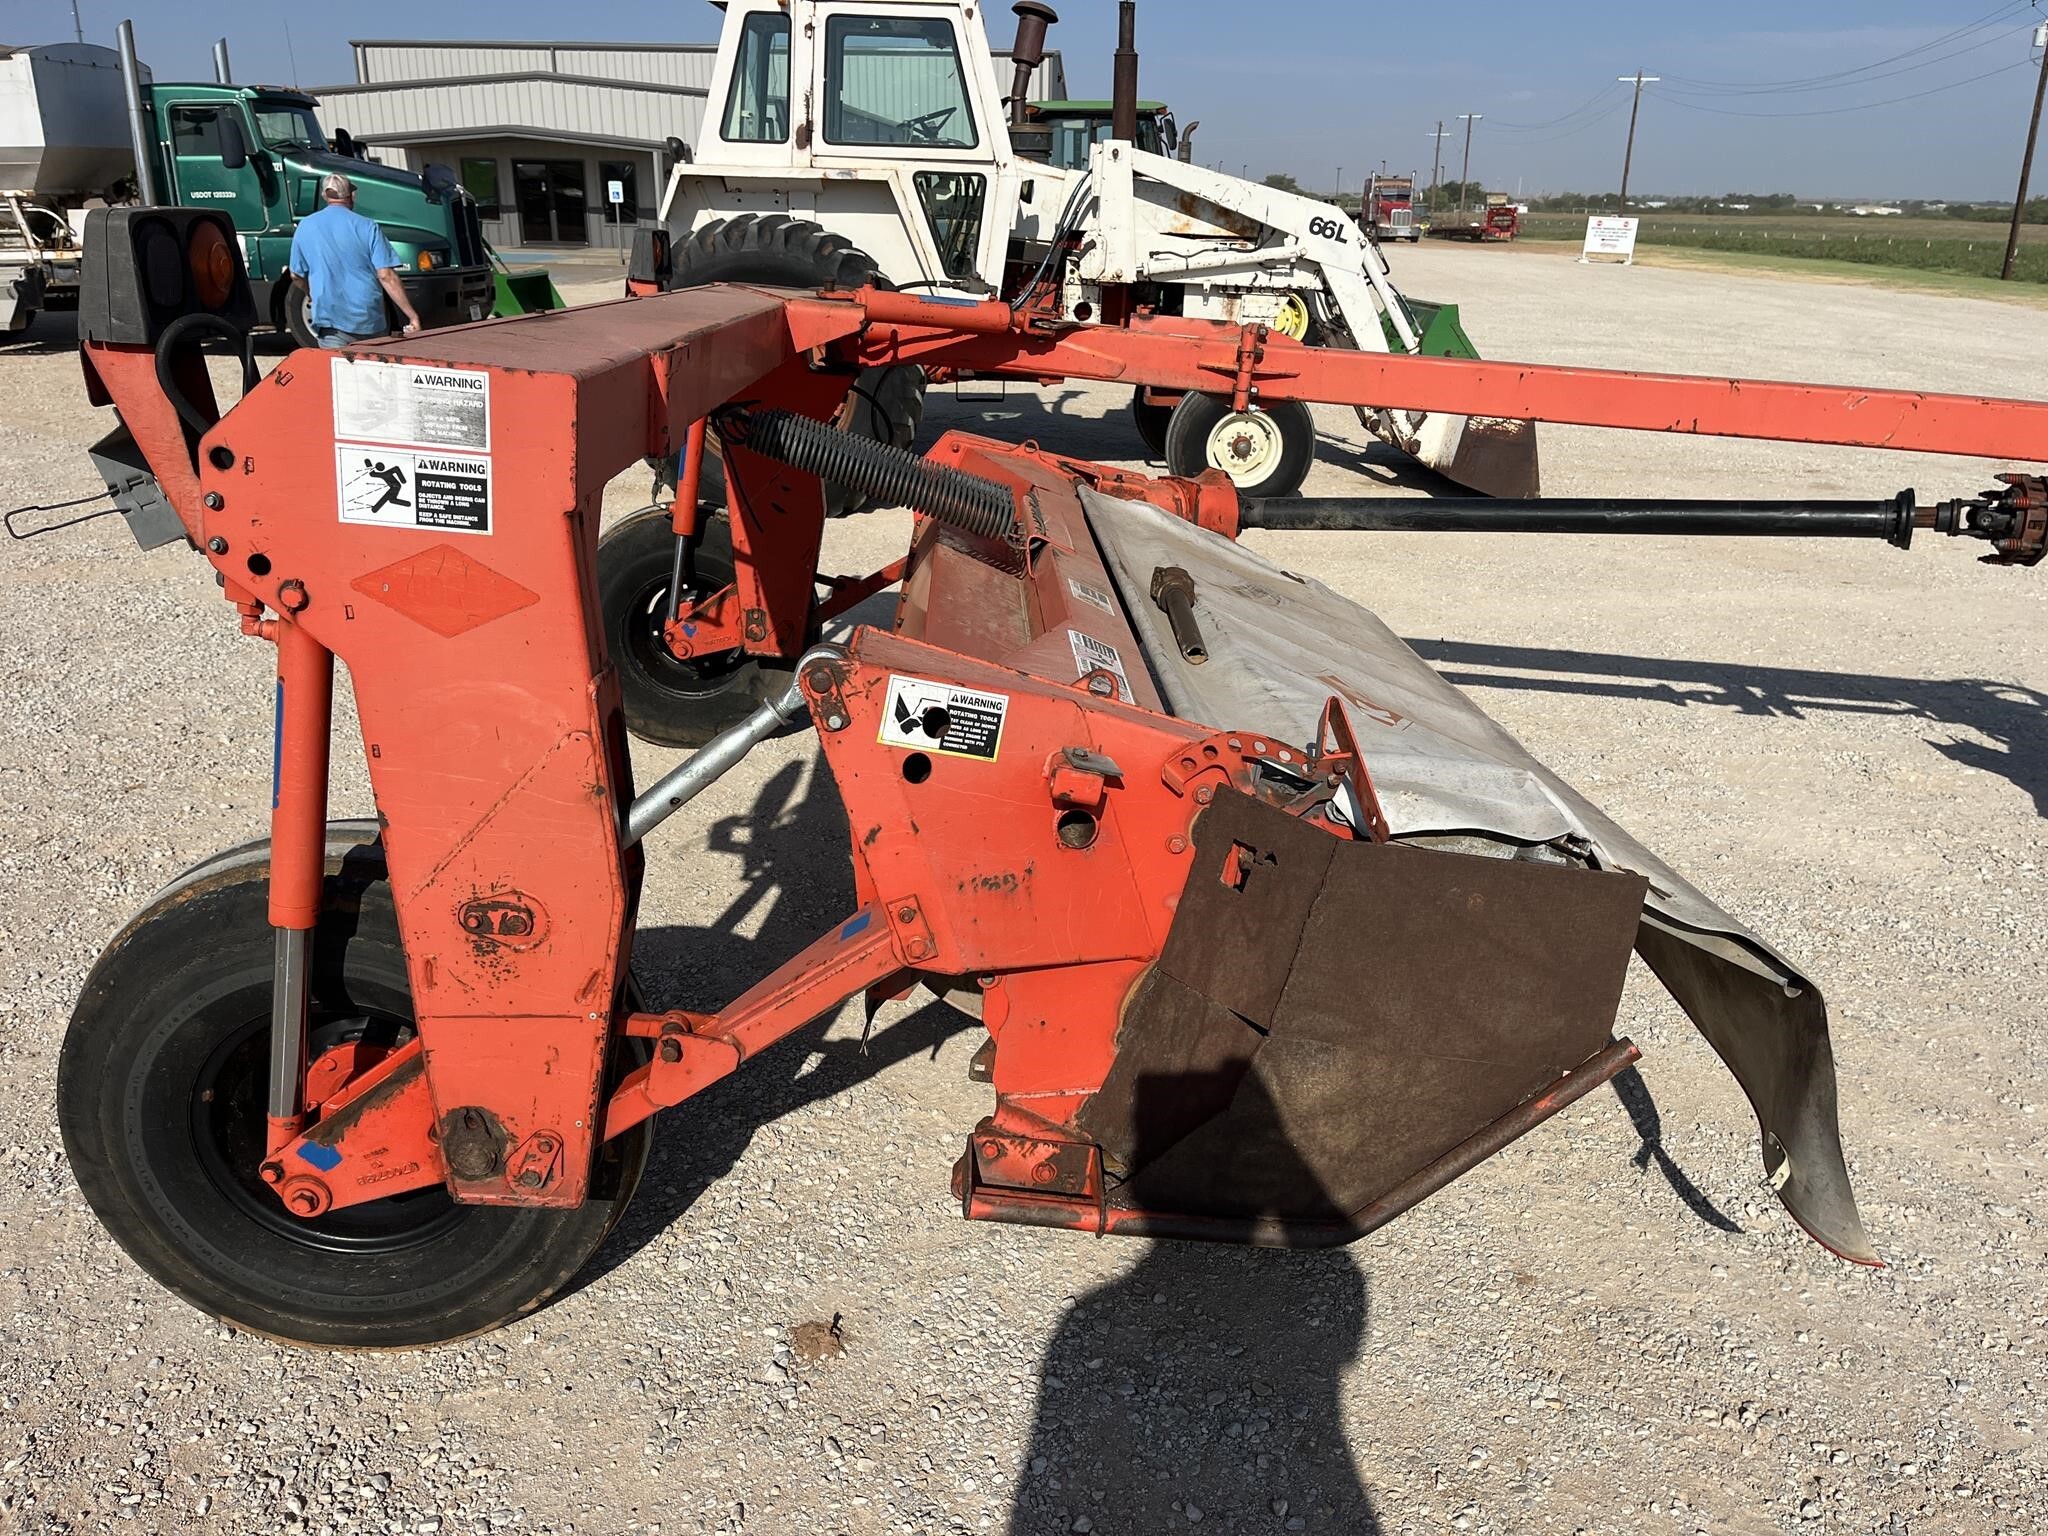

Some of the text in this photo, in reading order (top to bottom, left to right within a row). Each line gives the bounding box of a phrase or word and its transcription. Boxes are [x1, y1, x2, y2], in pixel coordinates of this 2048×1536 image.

[190, 191, 212, 199] USDOT
[1309, 216, 1348, 244] 66L
[426, 374, 482, 390] WARNING
[454, 400, 484, 408] HAZARD
[428, 460, 486, 474] WARNING
[422, 480, 482, 492] ROTATING TOOLS
[960, 694, 1002, 710] WARNING
[950, 710, 998, 722] ROTATING TOOLS
[942, 742, 968, 750] CONNECTED
